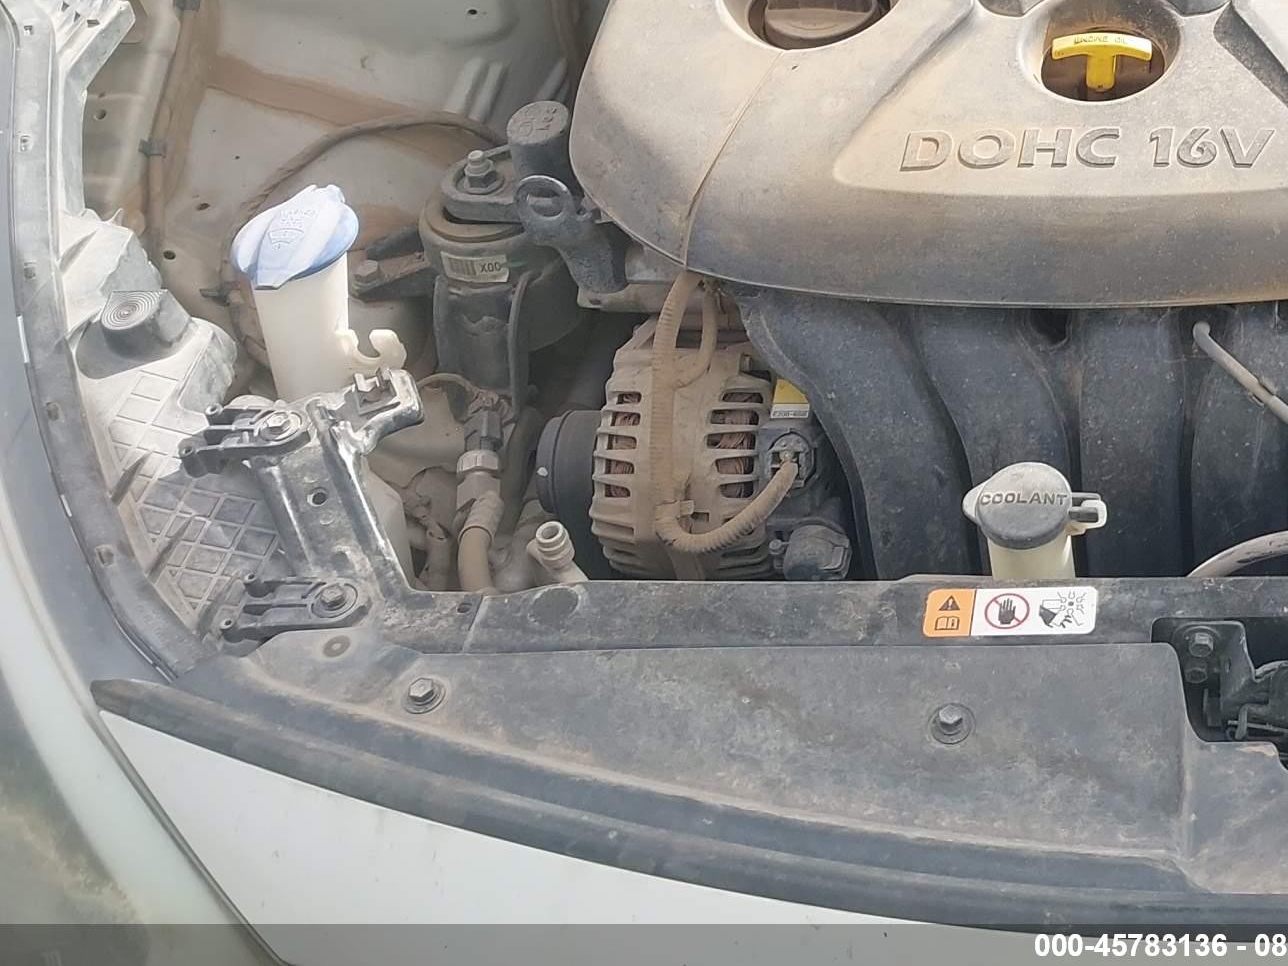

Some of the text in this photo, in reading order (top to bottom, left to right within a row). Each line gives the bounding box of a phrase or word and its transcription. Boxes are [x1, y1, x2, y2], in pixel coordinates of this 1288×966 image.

[899, 127, 1275, 172] DOHC 16V
[980, 492, 1068, 506] COOLANT
